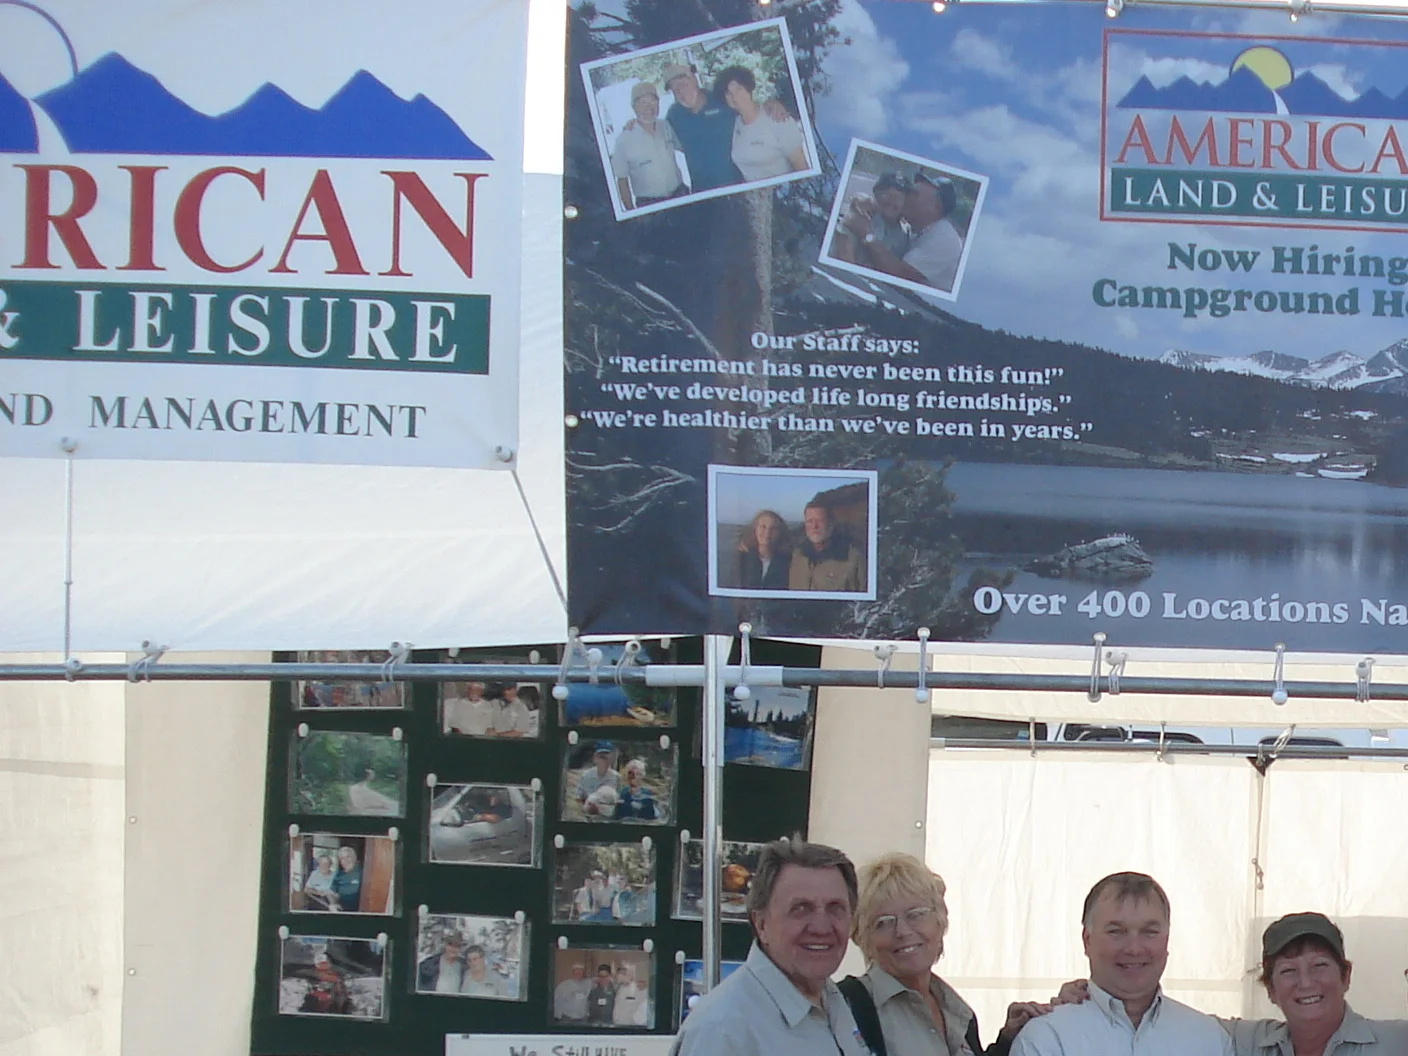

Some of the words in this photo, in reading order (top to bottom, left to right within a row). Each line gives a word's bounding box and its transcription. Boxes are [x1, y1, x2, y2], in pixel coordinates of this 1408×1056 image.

[1124, 177, 1238, 208] LAND
[1252, 181, 1279, 211] &
[1168, 243, 1260, 273] Now
[1092, 278, 1360, 318] Campground
[72, 290, 458, 364] LEISURE
[751, 332, 797, 350] Our
[802, 333, 863, 352] Staff
[864, 336, 919, 357] says:
[762, 358, 802, 378] has
[808, 363, 878, 381] never
[883, 362, 940, 382] been
[947, 365, 994, 384] this
[686, 382, 805, 406] developed
[811, 386, 850, 406] life
[856, 387, 909, 411] long
[88, 395, 427, 438] MANAGEMENT
[662, 409, 773, 431] healthier
[777, 413, 835, 433] than
[916, 417, 974, 437] been
[980, 419, 1005, 438] in
[973, 586, 1067, 615] Over
[1077, 590, 1151, 619] 400
[1160, 592, 1350, 625] Locations
